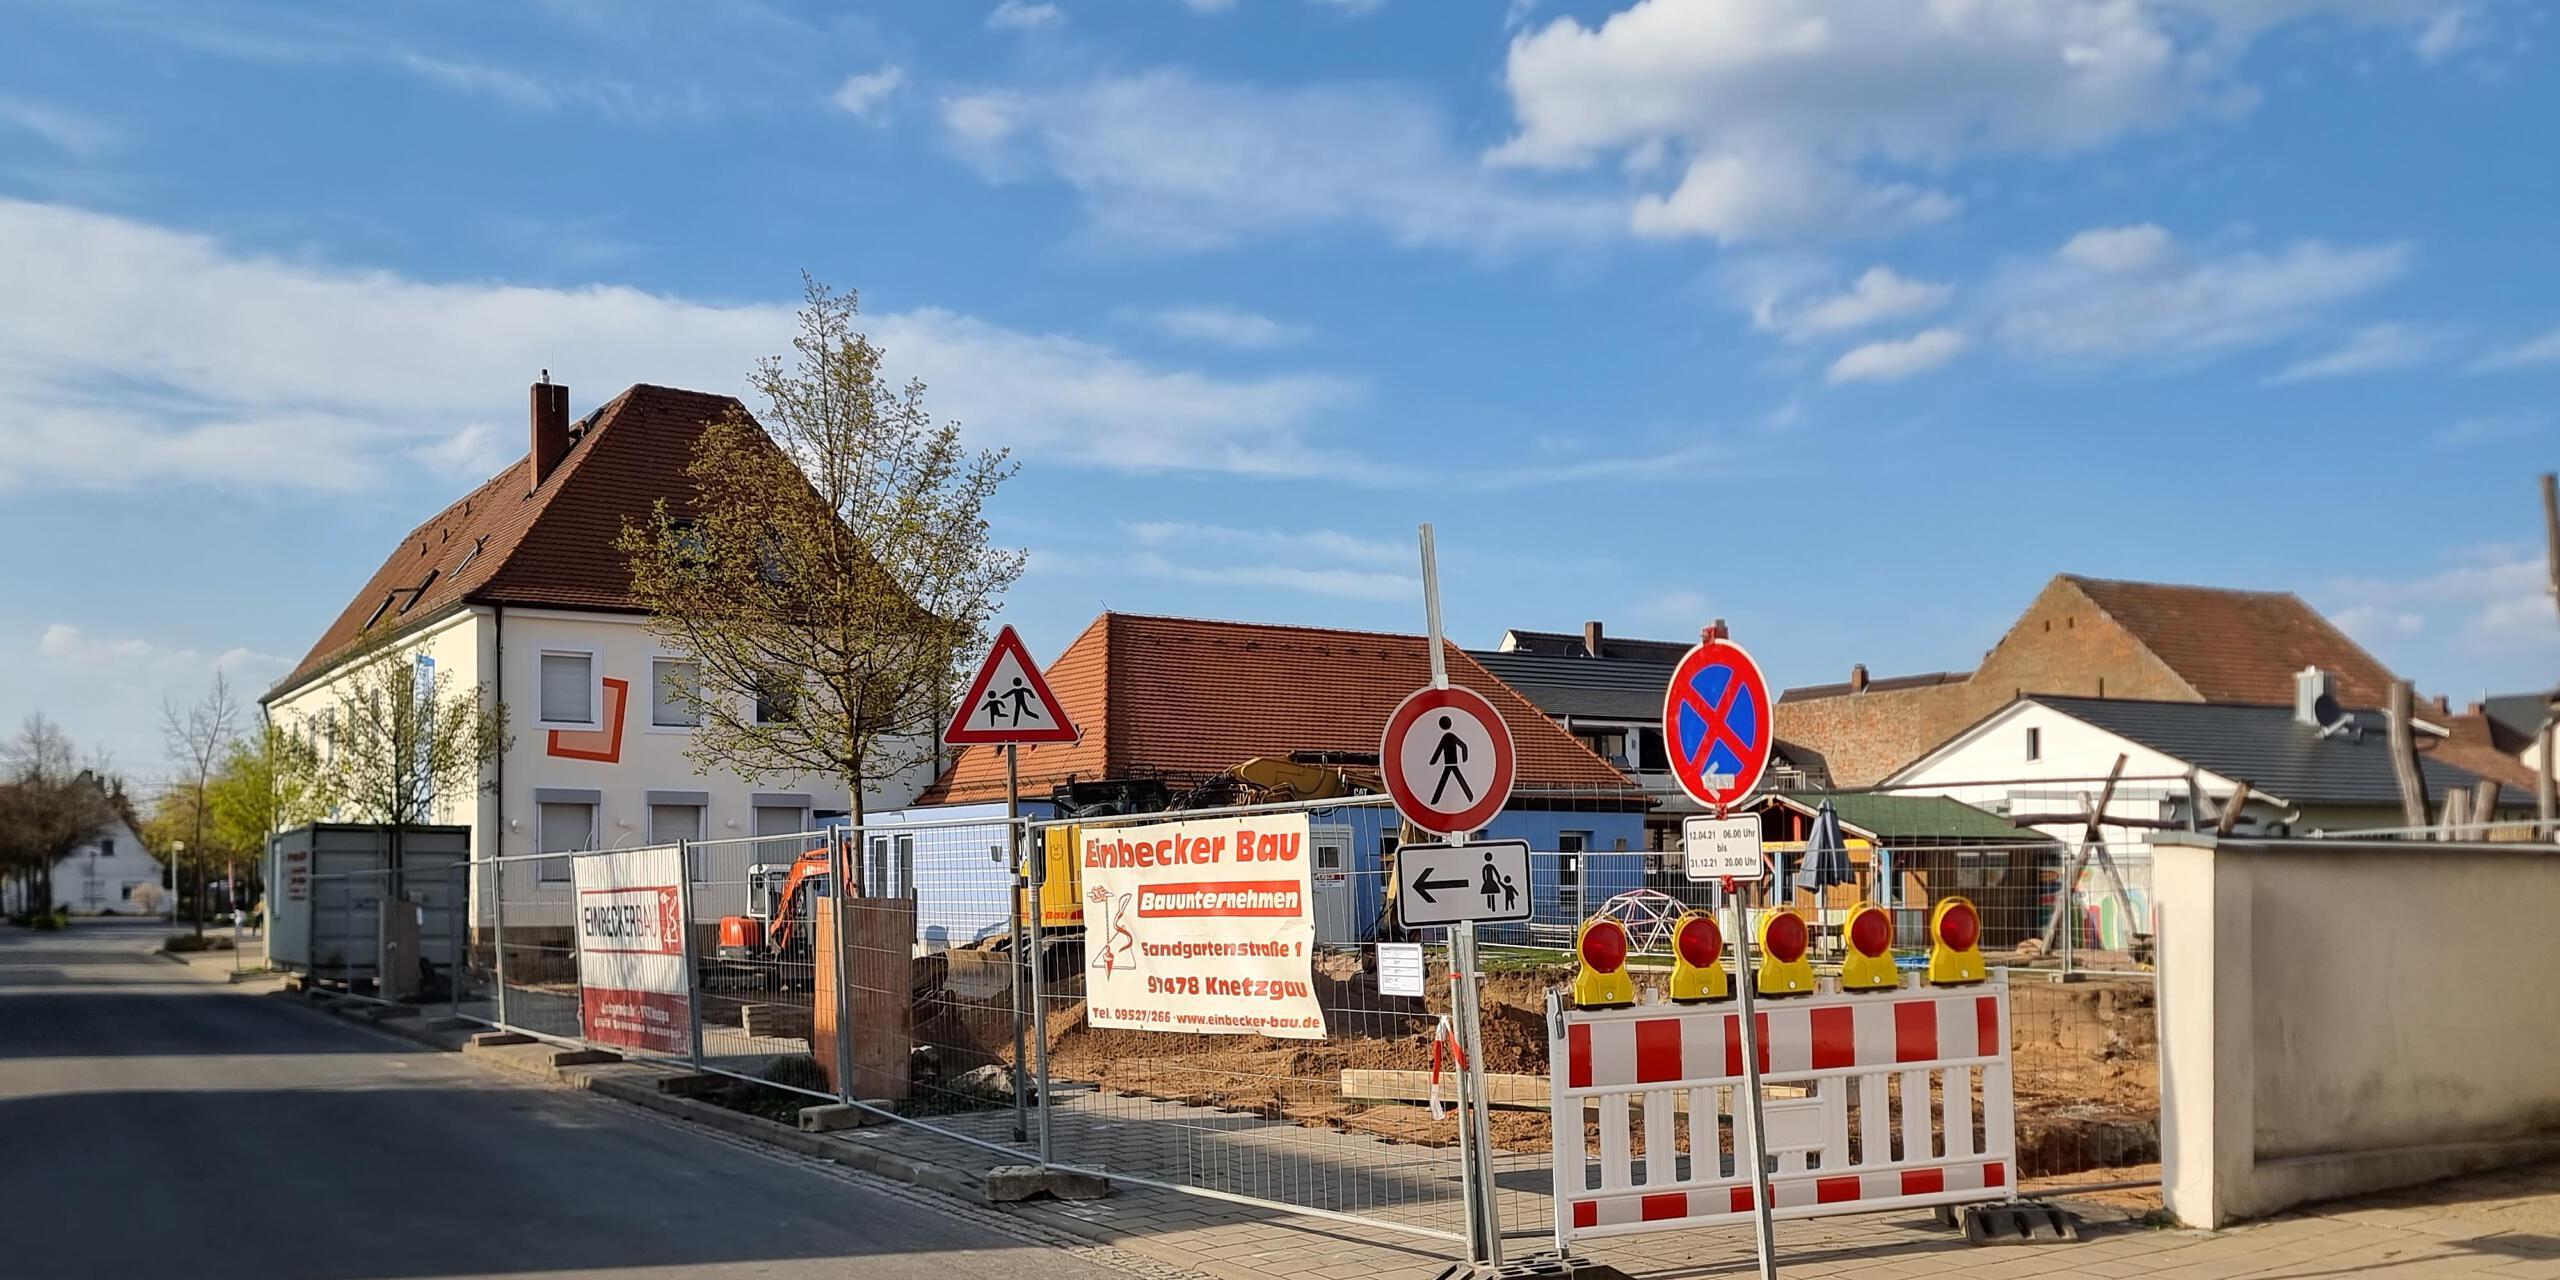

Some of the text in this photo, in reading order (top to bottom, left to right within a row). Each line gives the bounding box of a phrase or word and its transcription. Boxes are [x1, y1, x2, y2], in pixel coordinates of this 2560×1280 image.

[1353, 788, 1368, 796] CAT
[1689, 828, 1756, 840] 12.04.21 06.00 Uhr
[1085, 830, 1301, 869] Einbecker Bau
[1717, 843, 1728, 852] bis
[1690, 856, 1757, 868] 31.12.21 20.00 Uhr
[1140, 888, 1298, 911] Bauunternehmen
[1141, 941, 1289, 959] Sandgartenstraße
[1205, 976, 1308, 1001] Knetzgau
[1092, 1007, 1320, 1028] Tel. 09527/266 www.einbecker-bau.de
